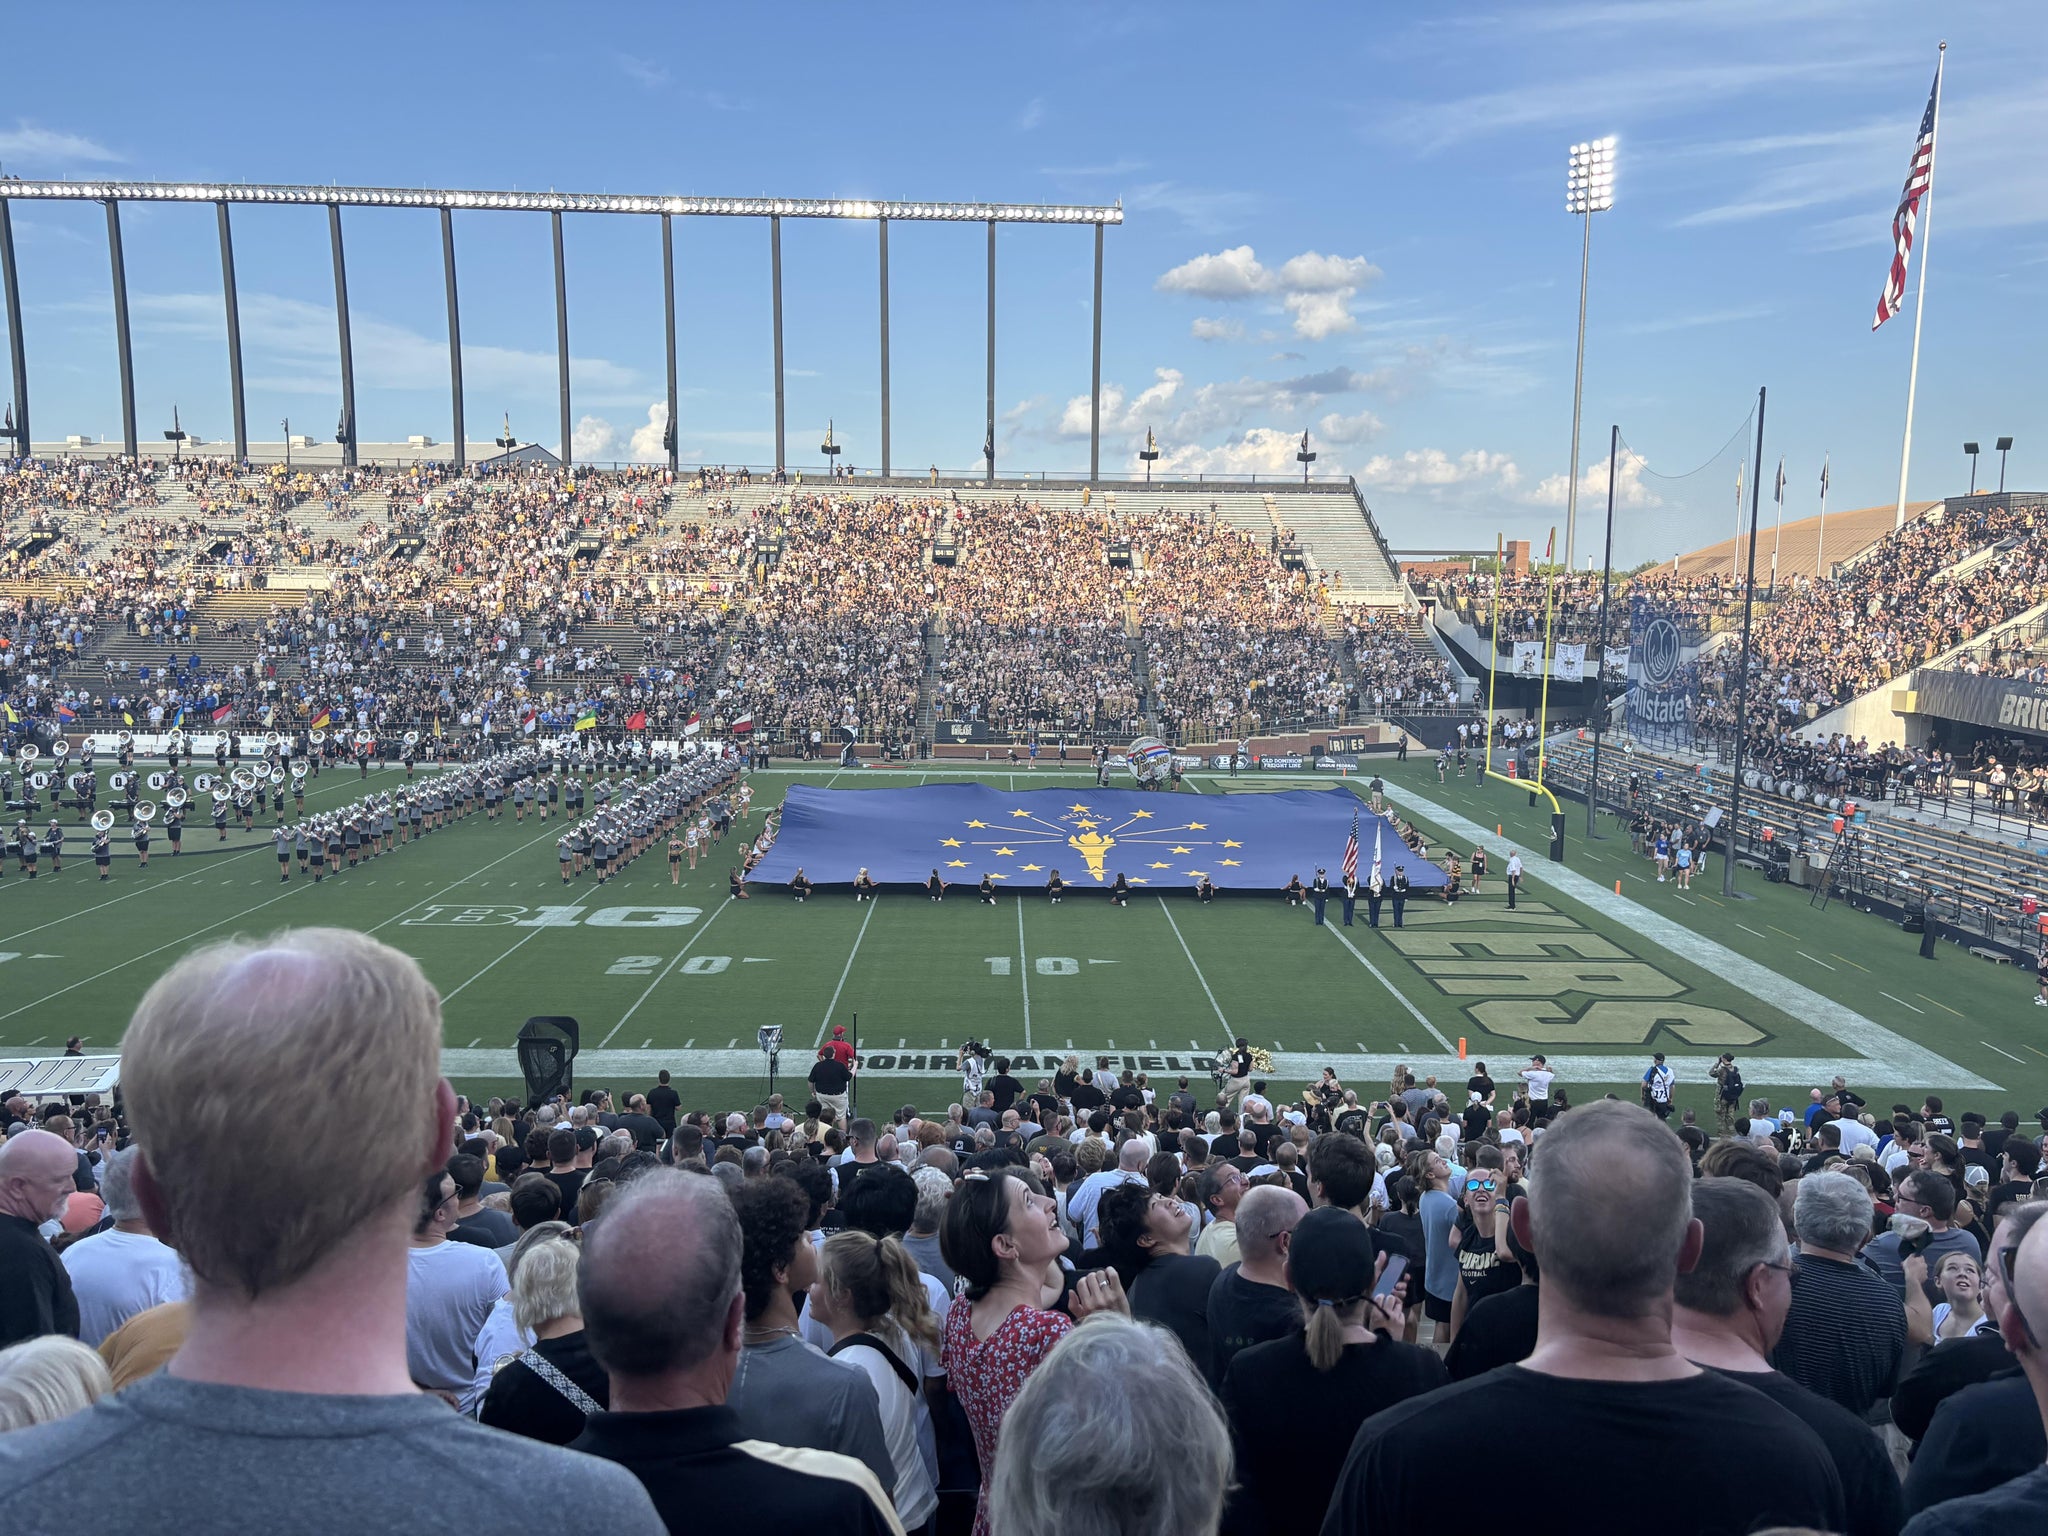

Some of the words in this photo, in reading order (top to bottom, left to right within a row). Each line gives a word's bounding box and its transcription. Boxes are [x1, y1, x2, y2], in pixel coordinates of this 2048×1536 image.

[1631, 687, 1686, 723] Allstate
[1057, 812, 1112, 822] INDIANA
[984, 956, 1080, 976] 10
[1096, 1055, 1216, 1071] FIELD
[1462, 1270, 1487, 1278] FOOTBALL
